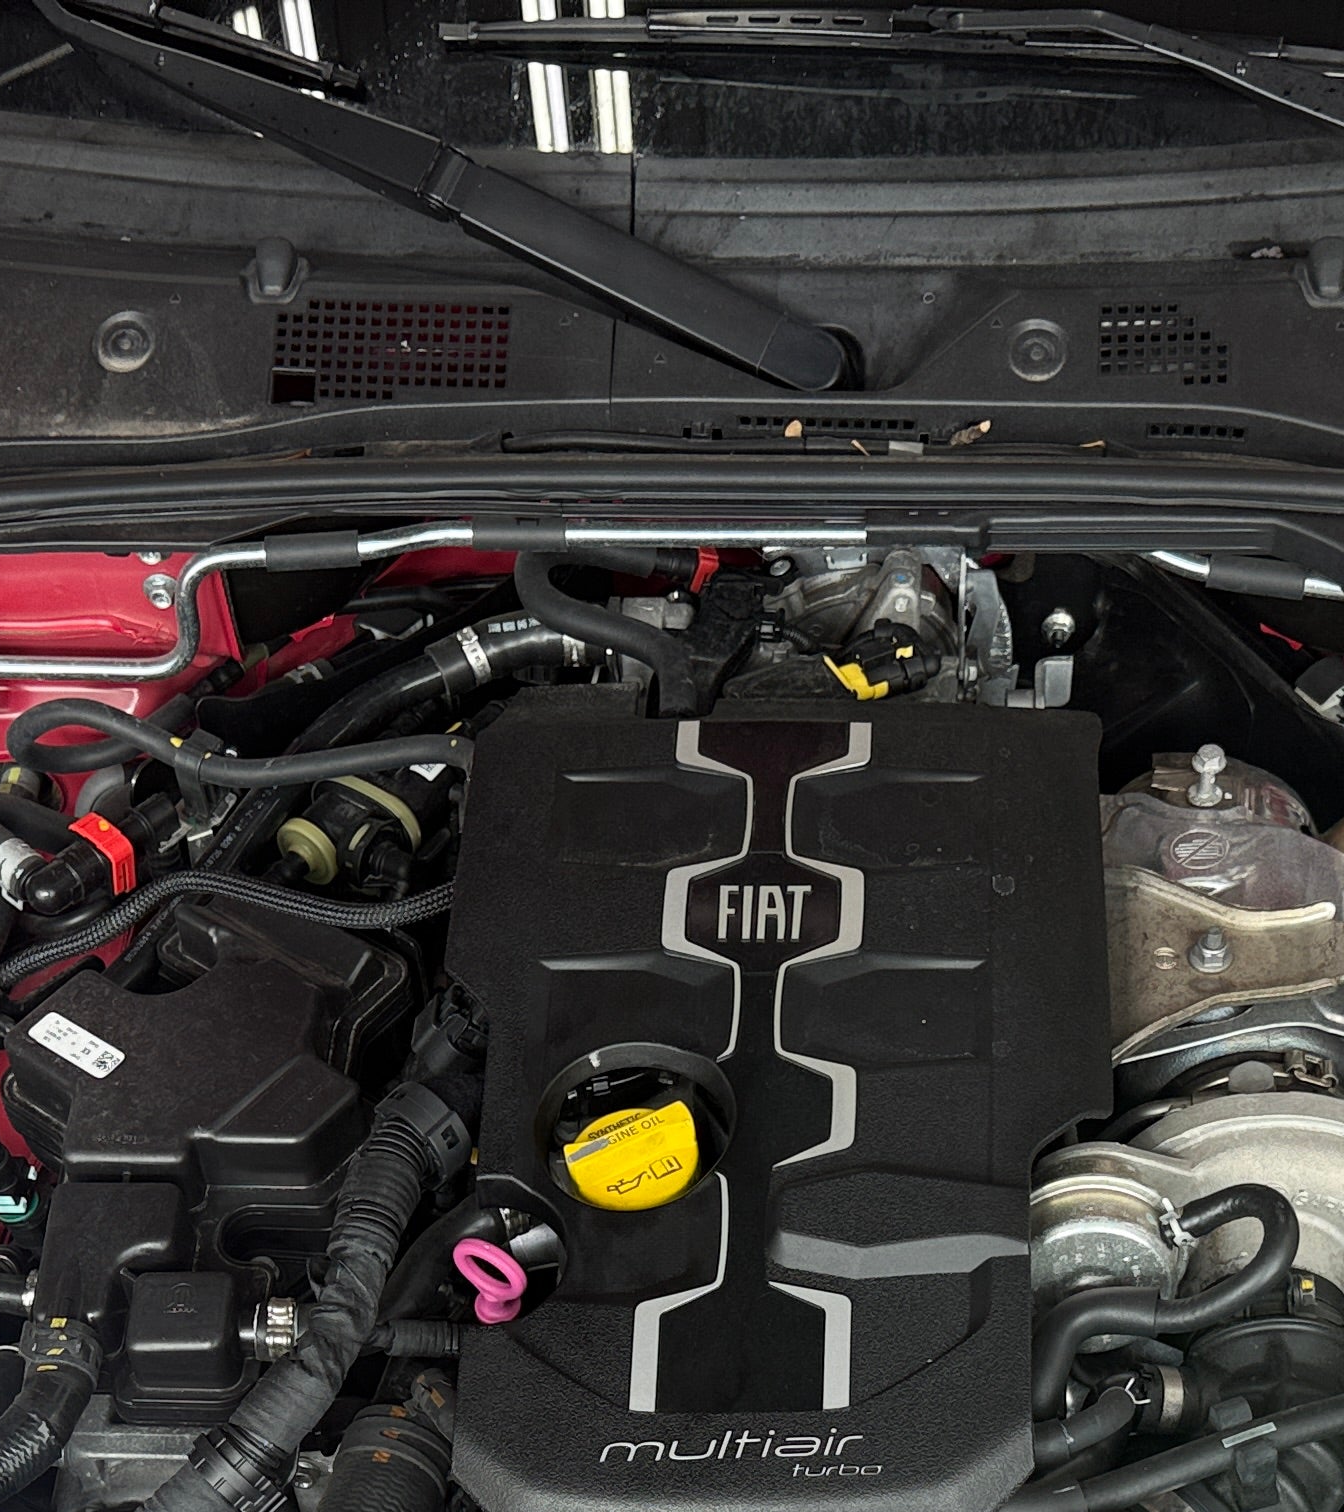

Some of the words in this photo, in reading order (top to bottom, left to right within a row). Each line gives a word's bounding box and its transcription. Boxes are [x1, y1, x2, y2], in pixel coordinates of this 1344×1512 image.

[717, 885, 812, 942] FIAT
[599, 1124, 640, 1148] GINE
[640, 1114, 666, 1131] OIL
[599, 1427, 864, 1463] multiair
[792, 1463, 883, 1477] turbo
